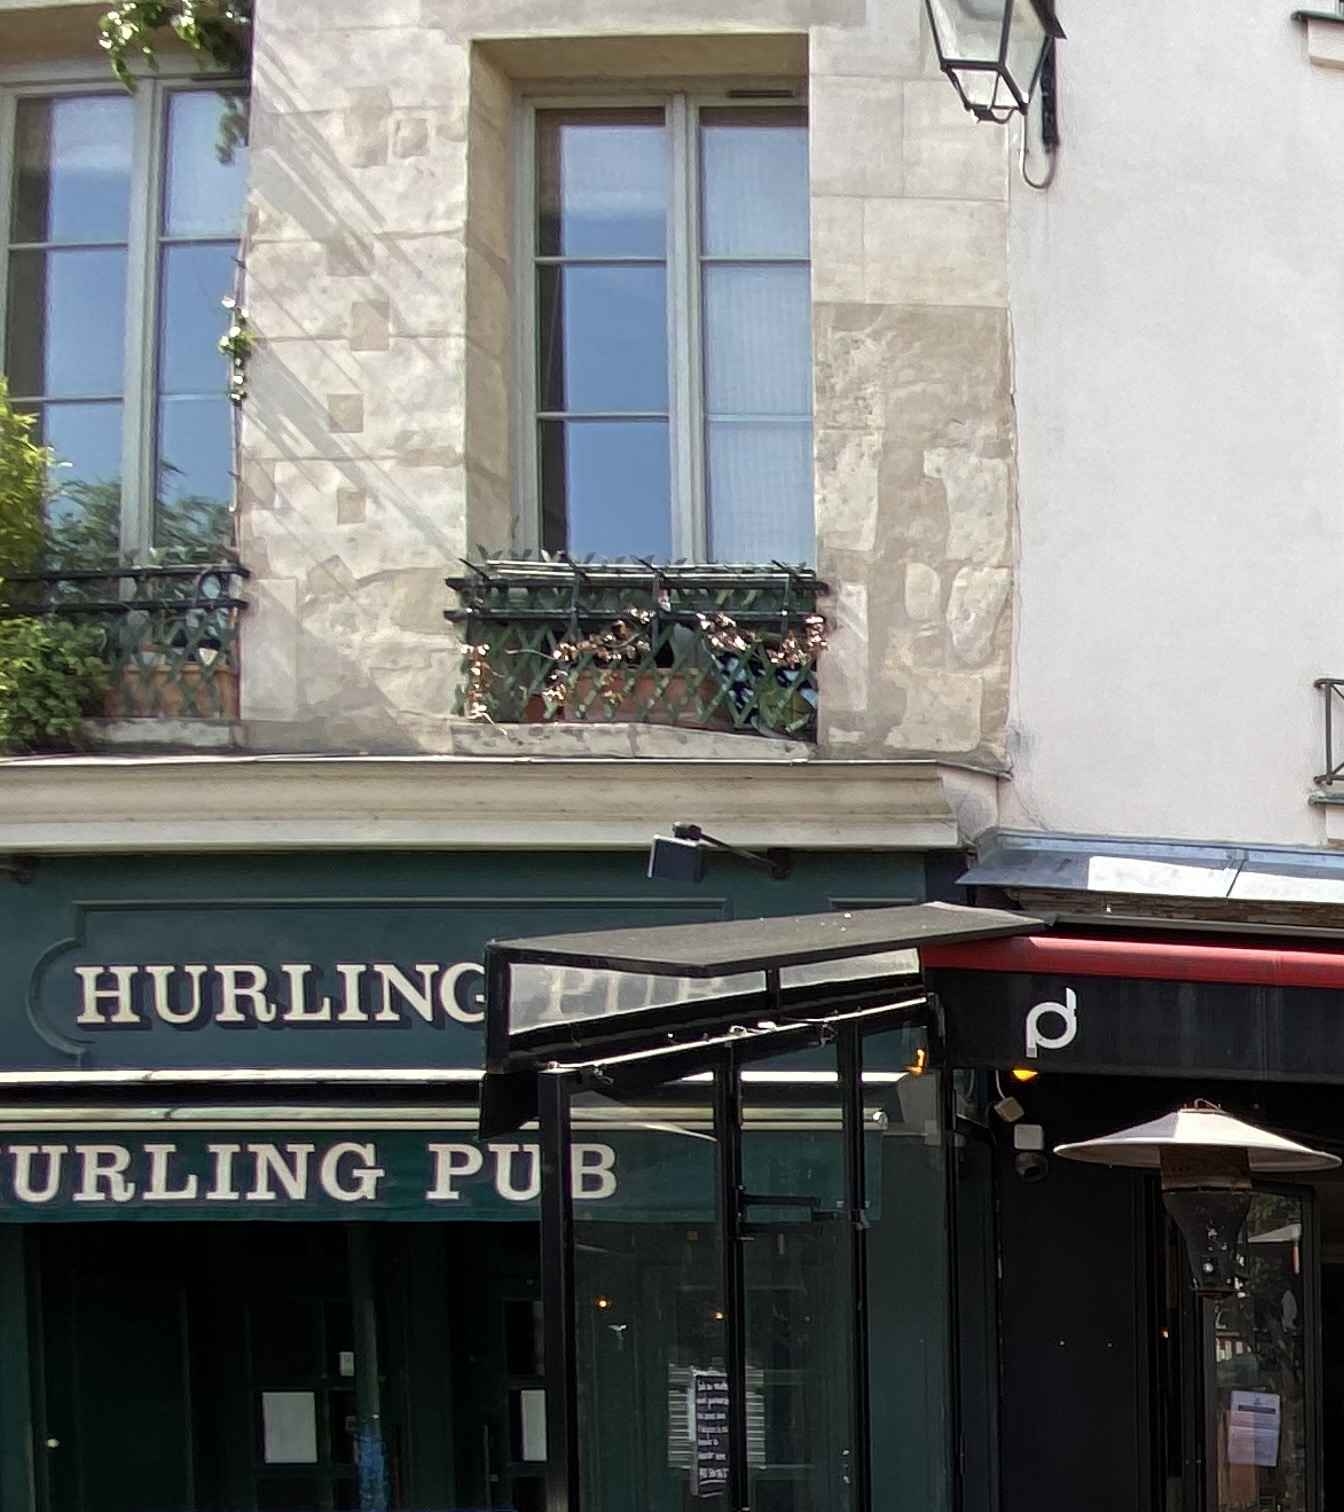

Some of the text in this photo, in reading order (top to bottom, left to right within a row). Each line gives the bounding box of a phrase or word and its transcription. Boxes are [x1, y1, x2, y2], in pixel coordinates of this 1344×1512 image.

[75, 961, 485, 1024] HURLING
[0, 1142, 617, 1203] URLING PUB
